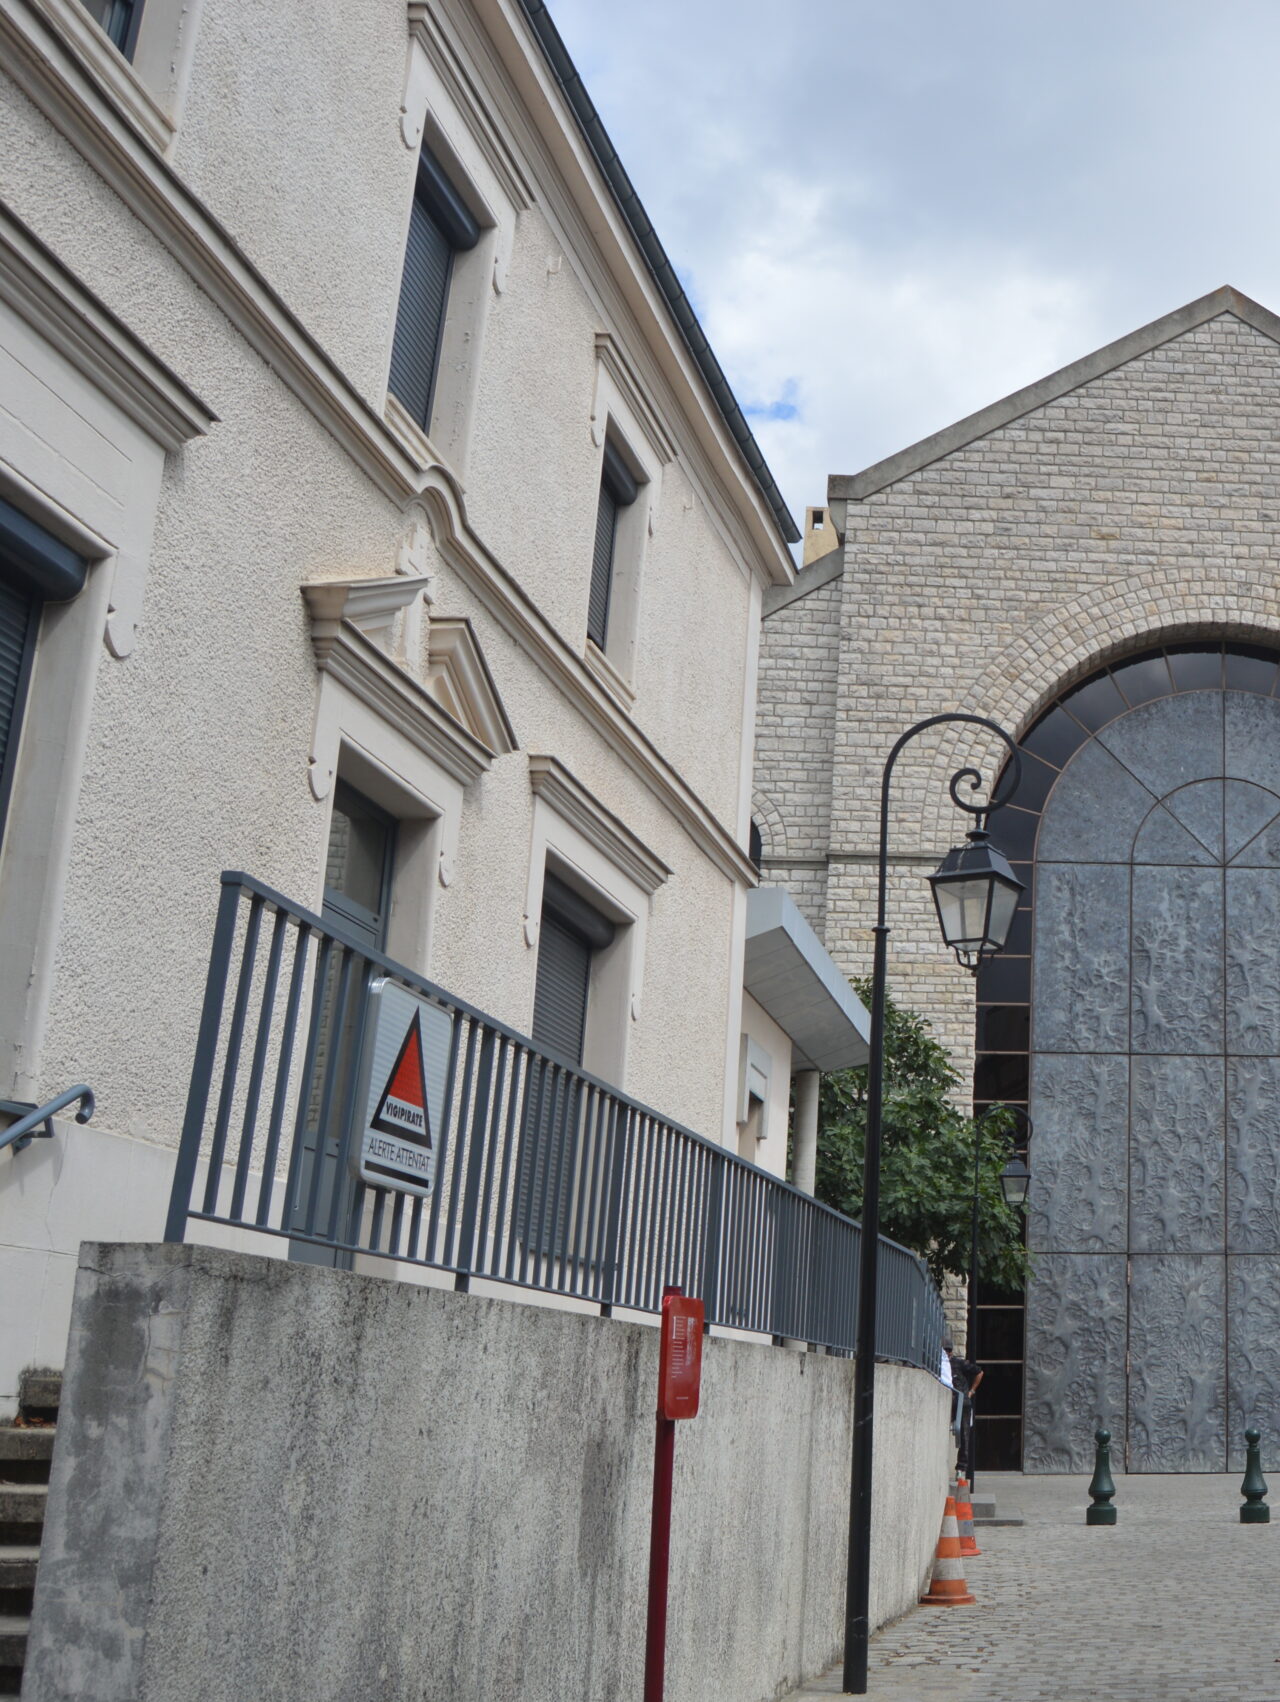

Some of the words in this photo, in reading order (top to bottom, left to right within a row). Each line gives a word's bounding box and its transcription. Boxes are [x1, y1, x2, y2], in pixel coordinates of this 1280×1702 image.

[386, 1101, 423, 1127] VIGIPIRATE
[368, 1138, 396, 1161] ALERTE
[395, 1147, 431, 1172] ATTENTAT
